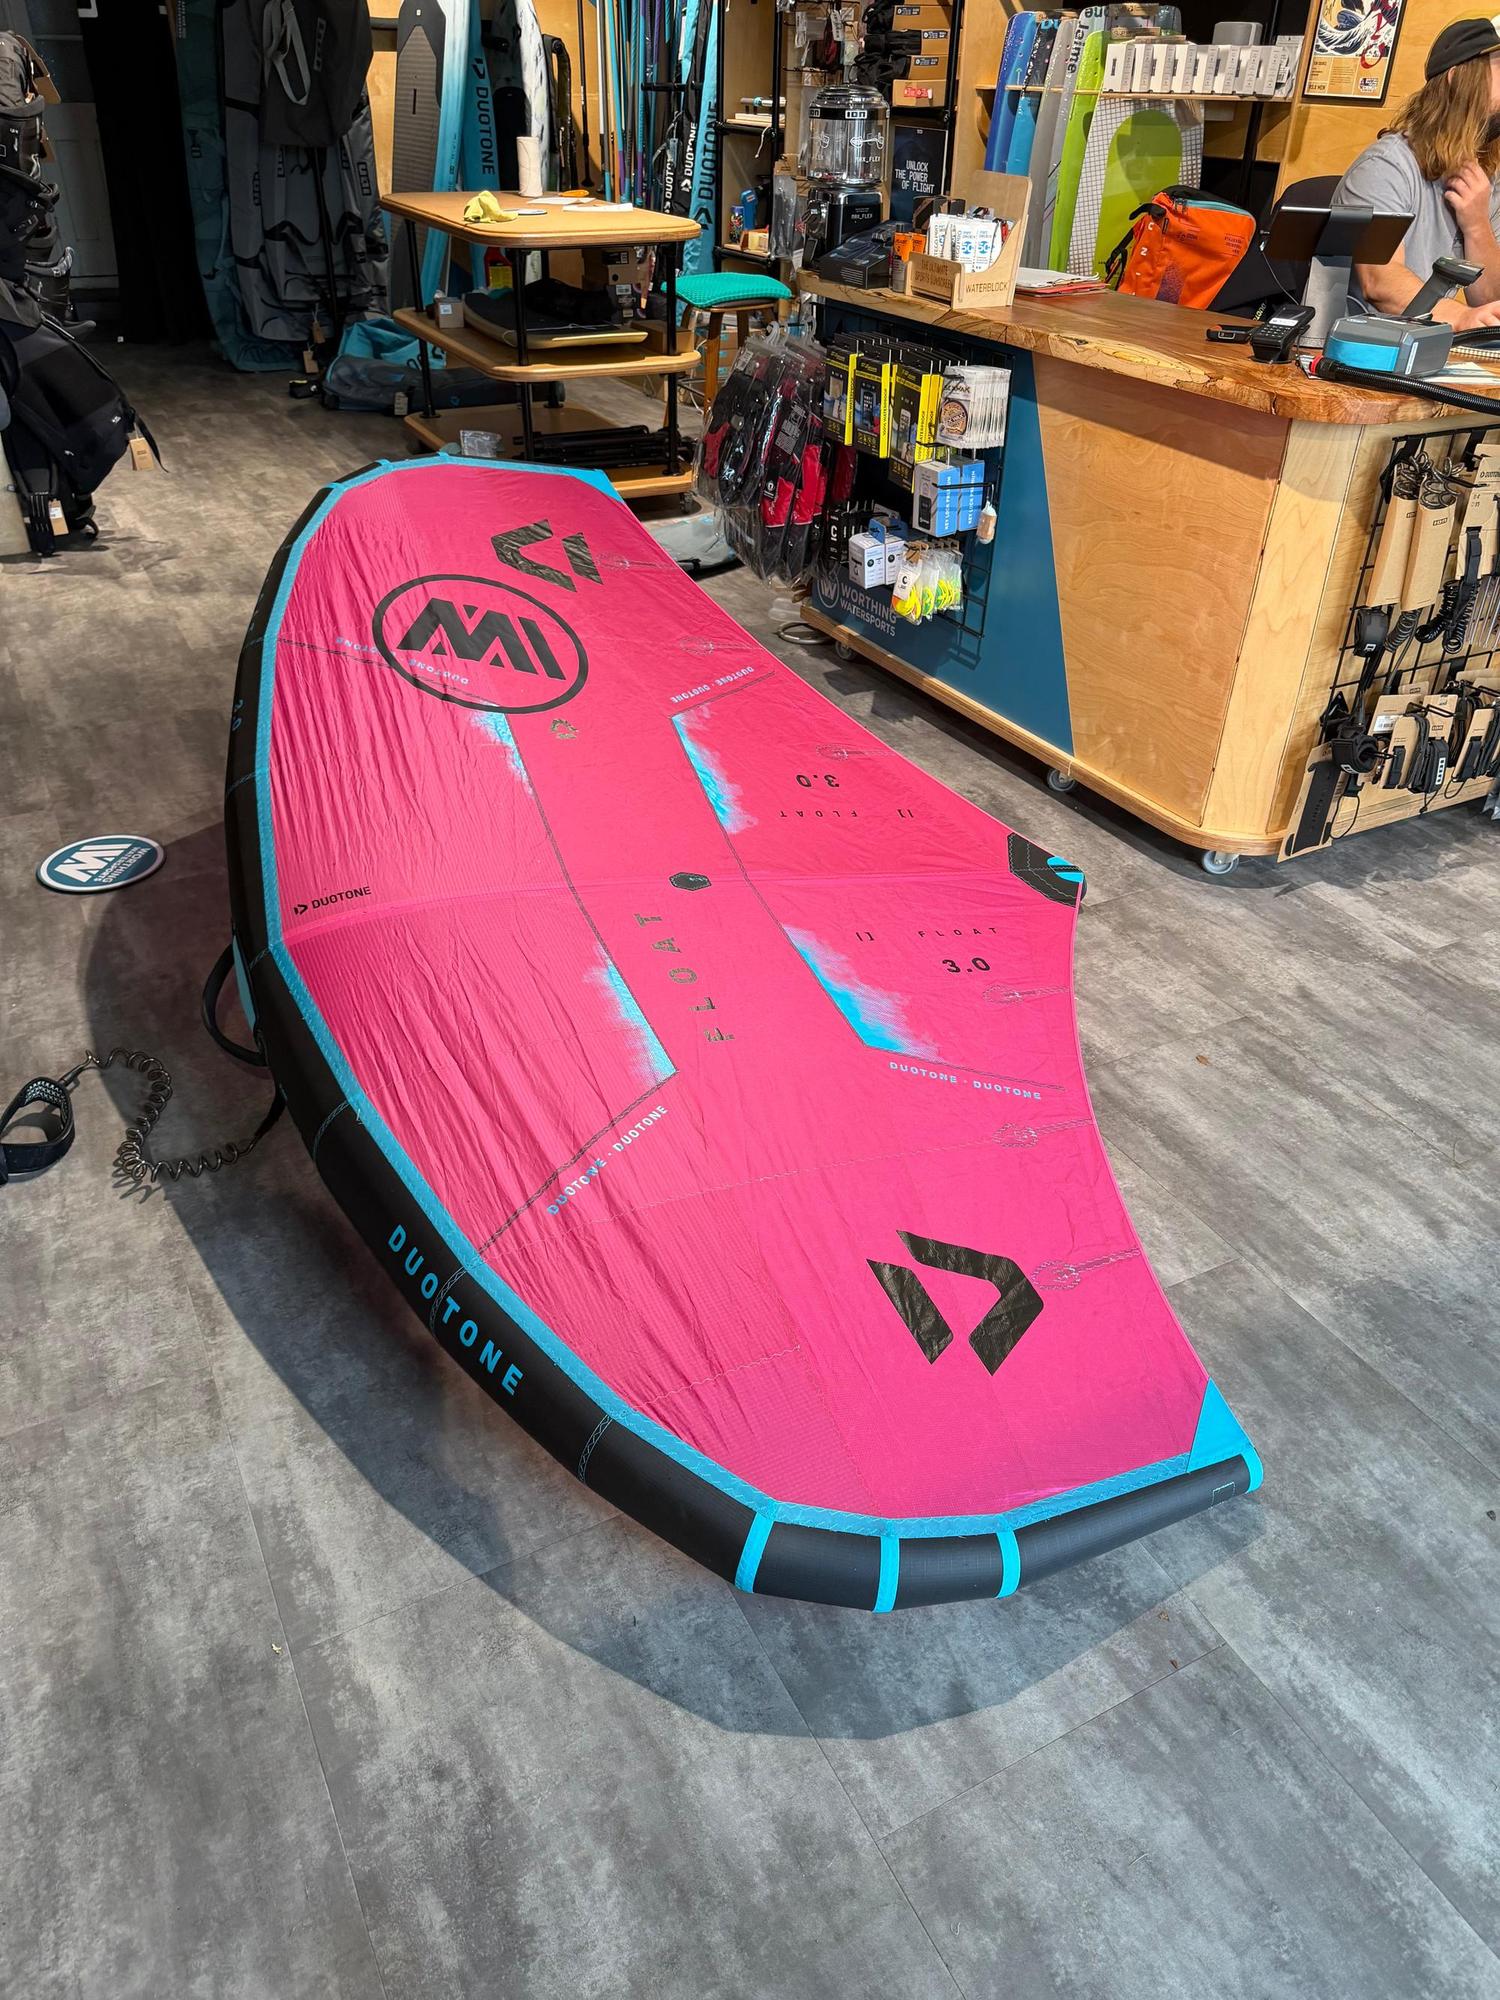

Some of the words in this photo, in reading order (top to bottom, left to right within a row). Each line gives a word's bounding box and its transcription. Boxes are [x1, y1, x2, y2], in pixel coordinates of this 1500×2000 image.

[475, 86, 495, 175] DUOTONE
[684, 122, 698, 176] DUOTONE
[665, 163, 674, 198] DUOTO
[895, 169, 906, 180] THE
[908, 171, 928, 183] POWER
[906, 160, 929, 172] UNLOCK
[901, 181, 911, 191] OF
[912, 181, 935, 194] FLIGHT
[965, 282, 1008, 293] WATERBLOCK
[840, 582, 898, 624] WORTHING
[840, 598, 896, 637] WATERSPORTS
[715, 665, 755, 687] DUOTONE
[671, 683, 715, 705] DUOTONE
[795, 773, 841, 789] 3.0
[102, 847, 152, 883] WORTHING
[311, 885, 372, 909] DUOTONE
[917, 926, 999, 938] FLOAT
[633, 912, 735, 1043] FLOAT
[941, 955, 992, 976] 3.0
[888, 1060, 958, 1084] DUOTONE
[972, 1079, 1042, 1101] DUOTONE
[546, 1156, 607, 1216] DUOTONE
[612, 1103, 668, 1153] DUOTONE
[386, 1222, 525, 1397] DUOTONE
